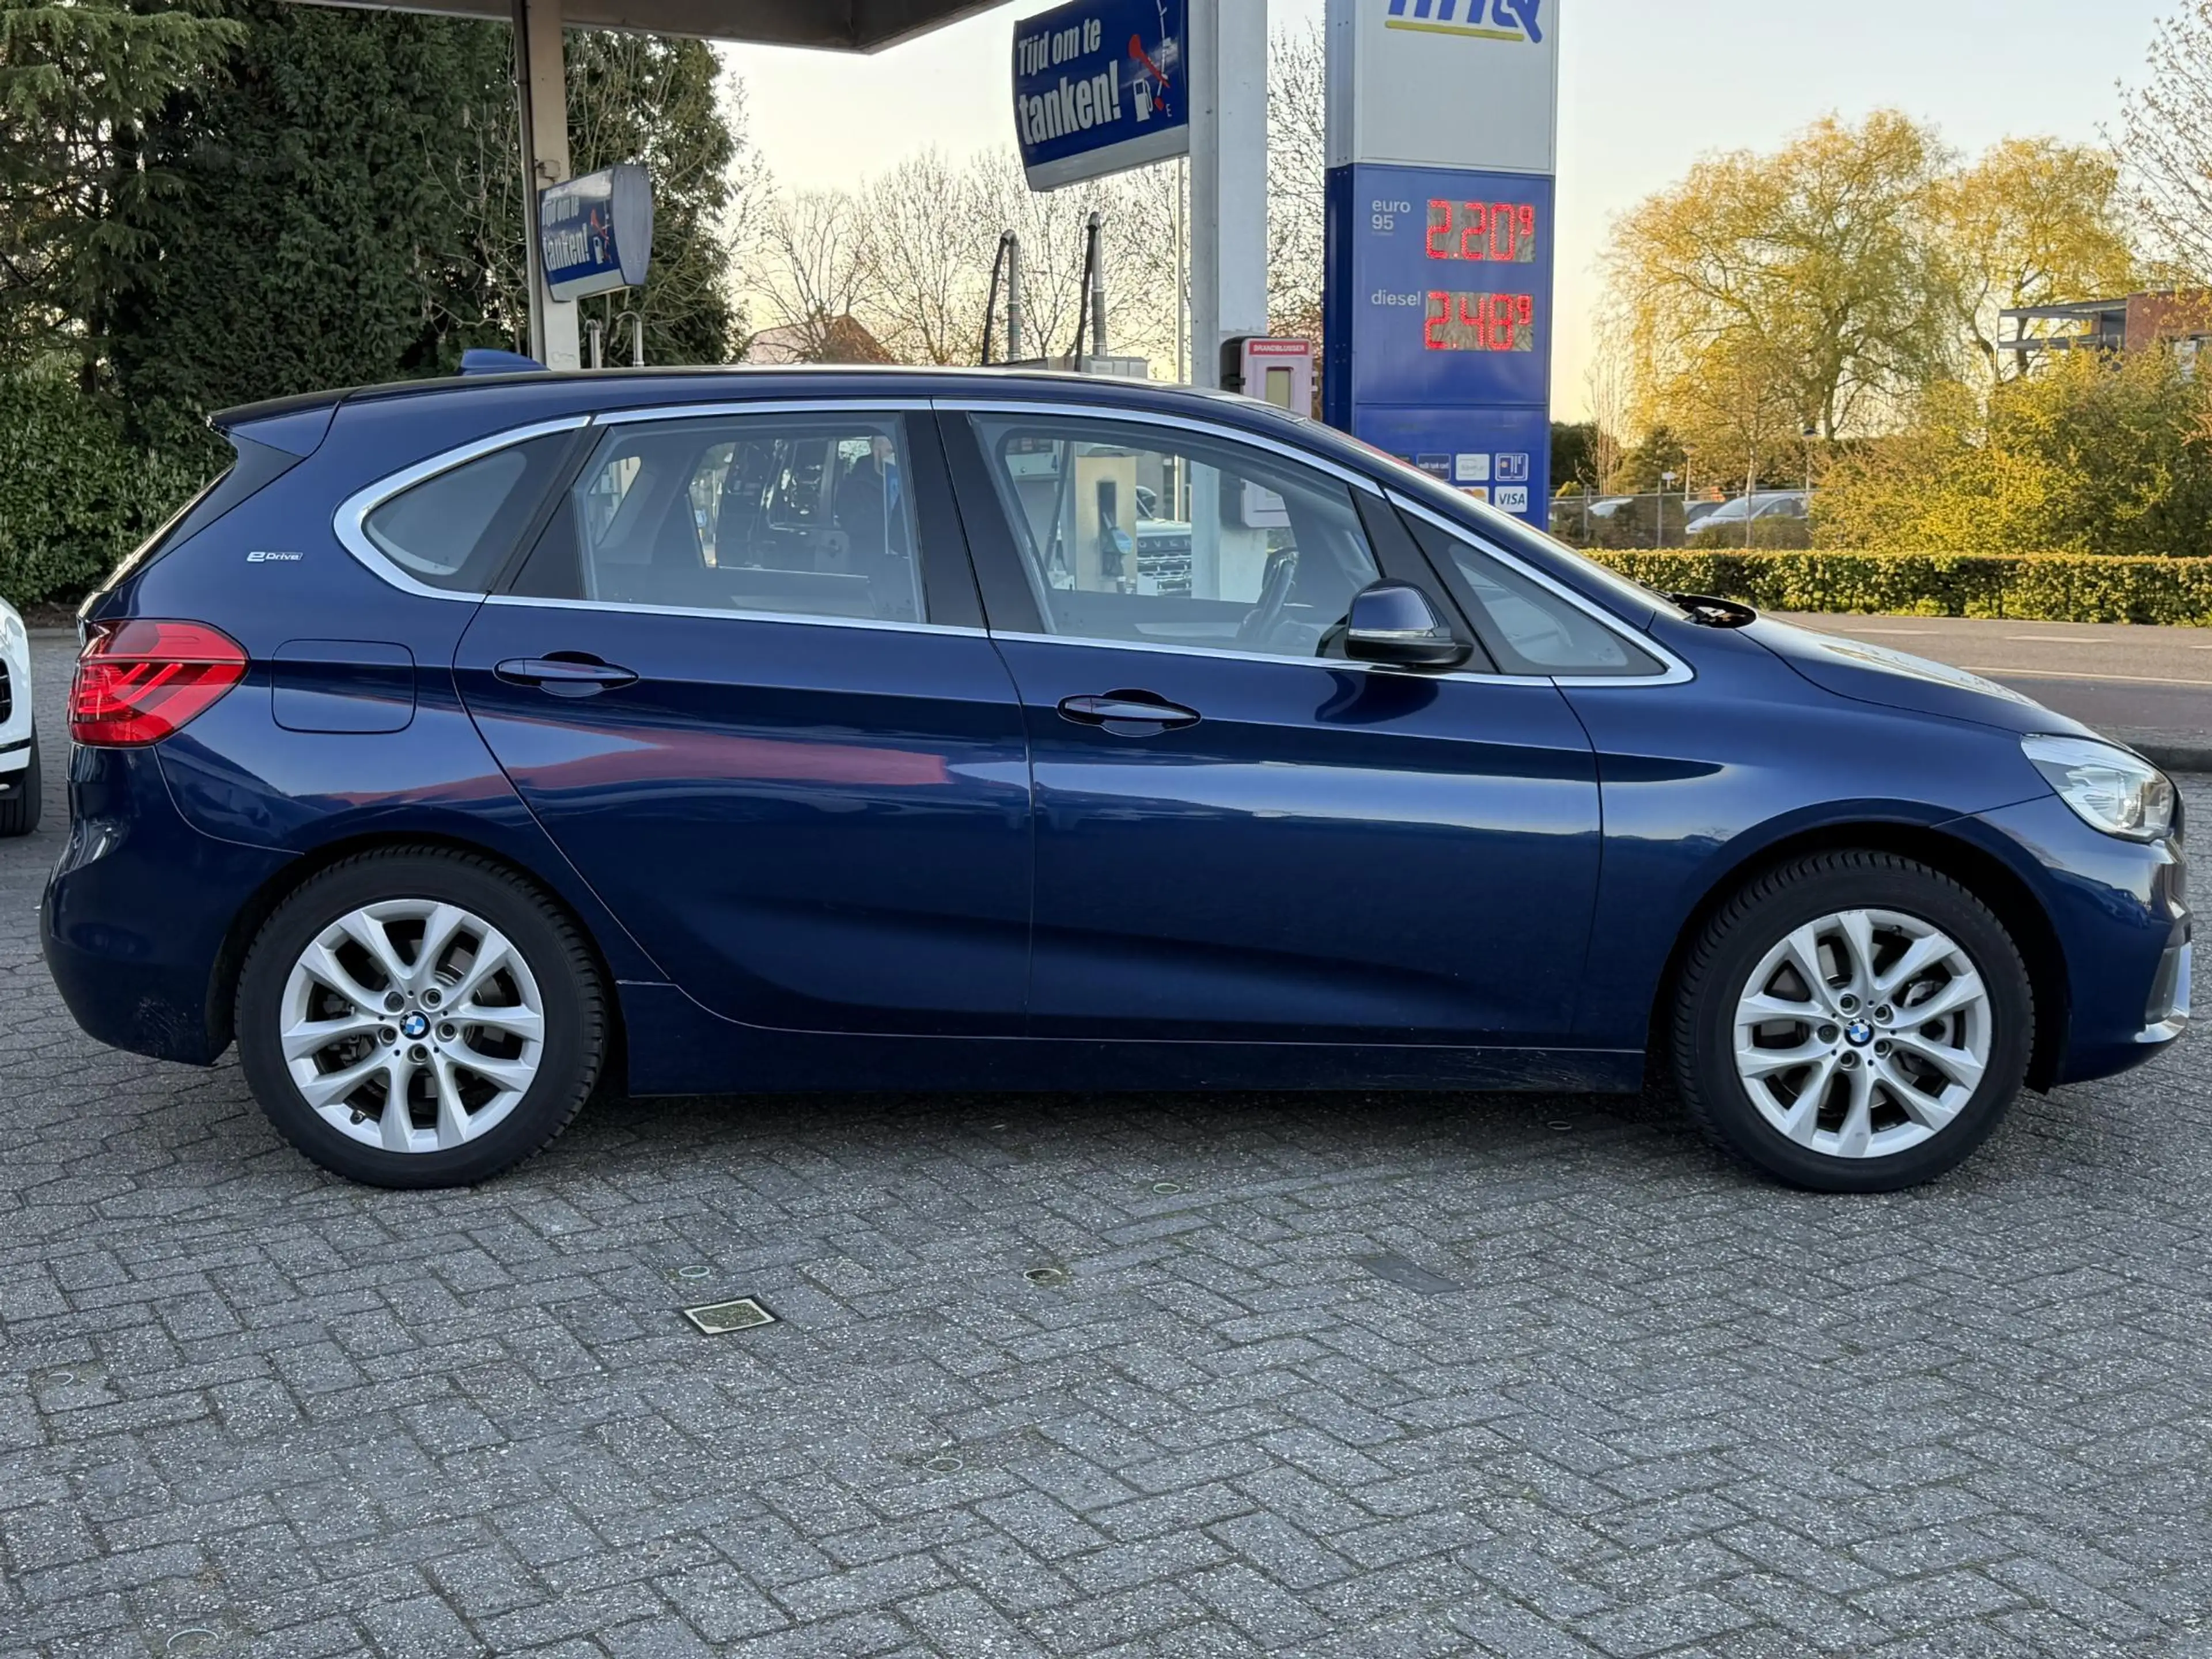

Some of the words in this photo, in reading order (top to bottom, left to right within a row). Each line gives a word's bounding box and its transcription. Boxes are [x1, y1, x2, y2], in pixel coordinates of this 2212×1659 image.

[1018, 31, 1050, 76] Tijd
[1052, 26, 1080, 65] om
[1083, 18, 1101, 54] te
[1018, 59, 1122, 146] tanken!
[1372, 199, 1411, 214] euro
[1372, 214, 1394, 230] 95
[1371, 289, 1421, 306] diesel
[1498, 493, 1525, 505] VISA
